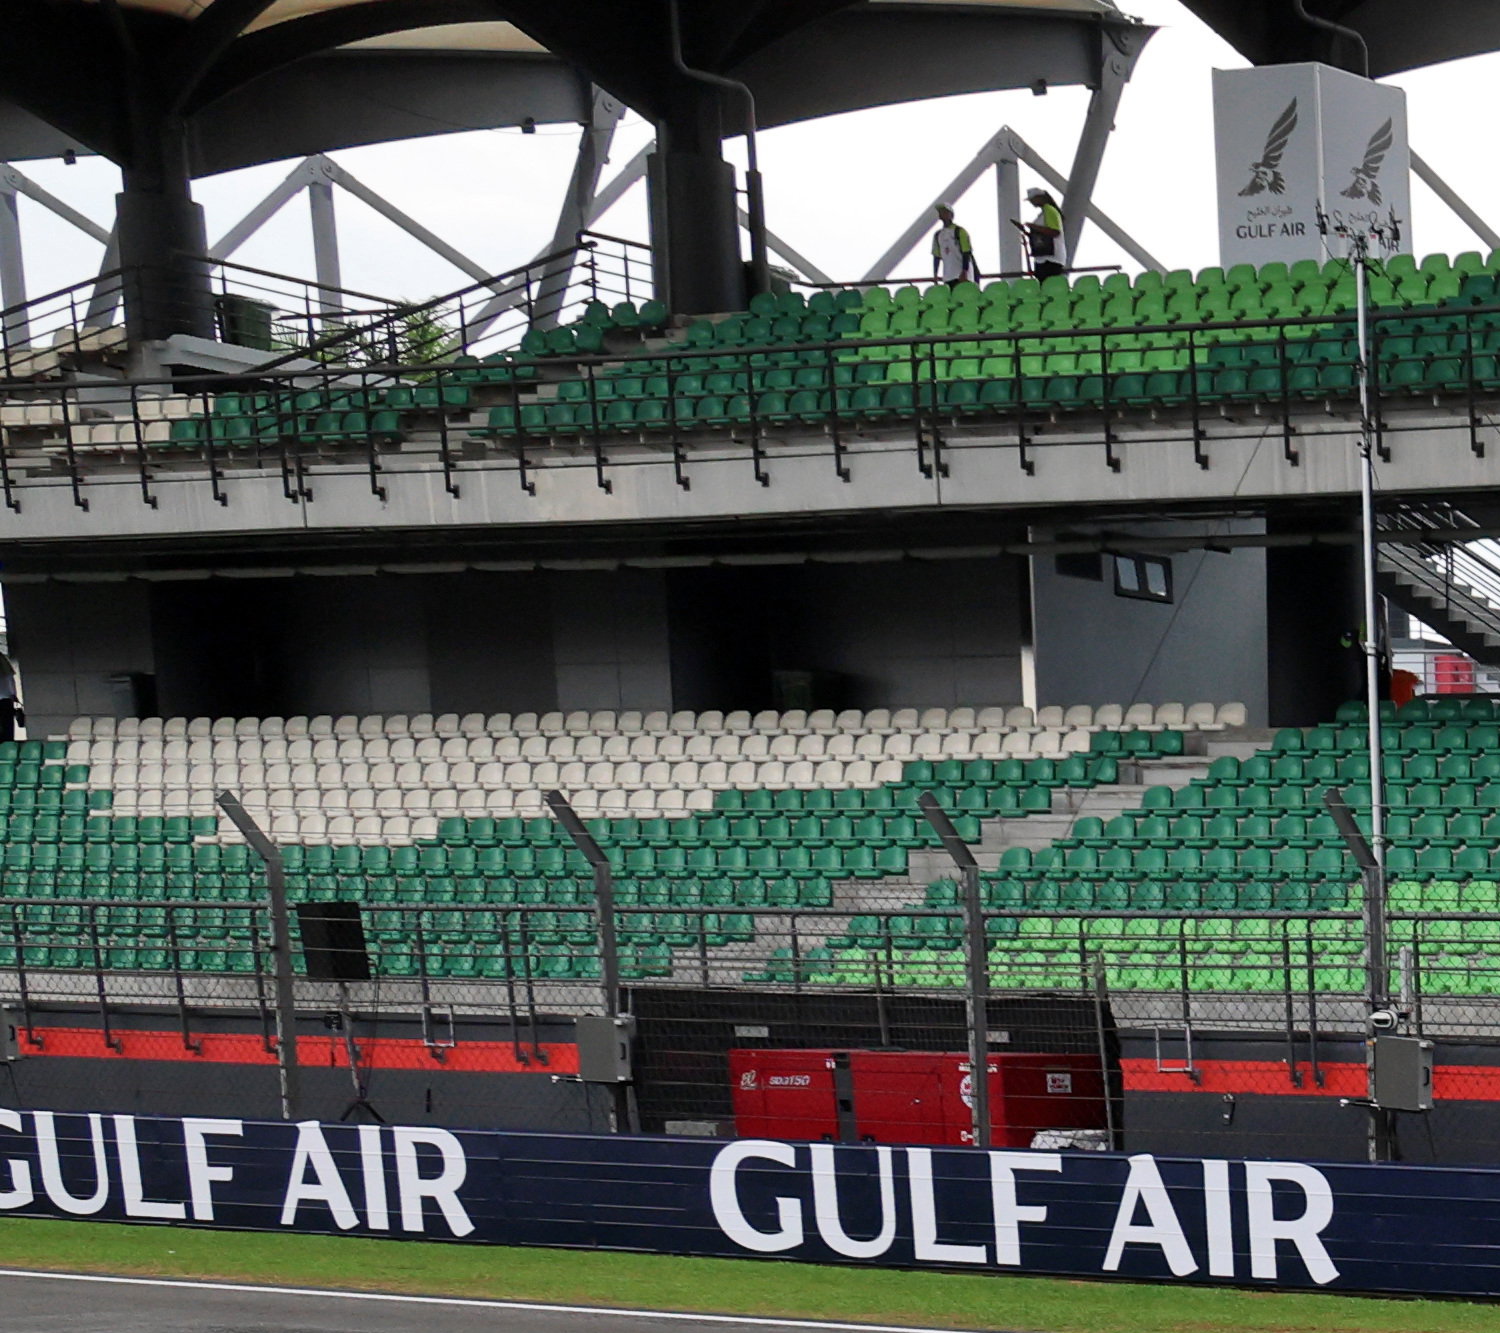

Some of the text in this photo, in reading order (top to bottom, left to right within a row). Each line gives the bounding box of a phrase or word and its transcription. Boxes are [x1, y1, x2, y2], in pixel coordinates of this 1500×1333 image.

[1236, 222, 1306, 239] GULF AIR
[280, 1120, 475, 1237] AIR
[710, 1139, 1340, 1285] GULF AIR
